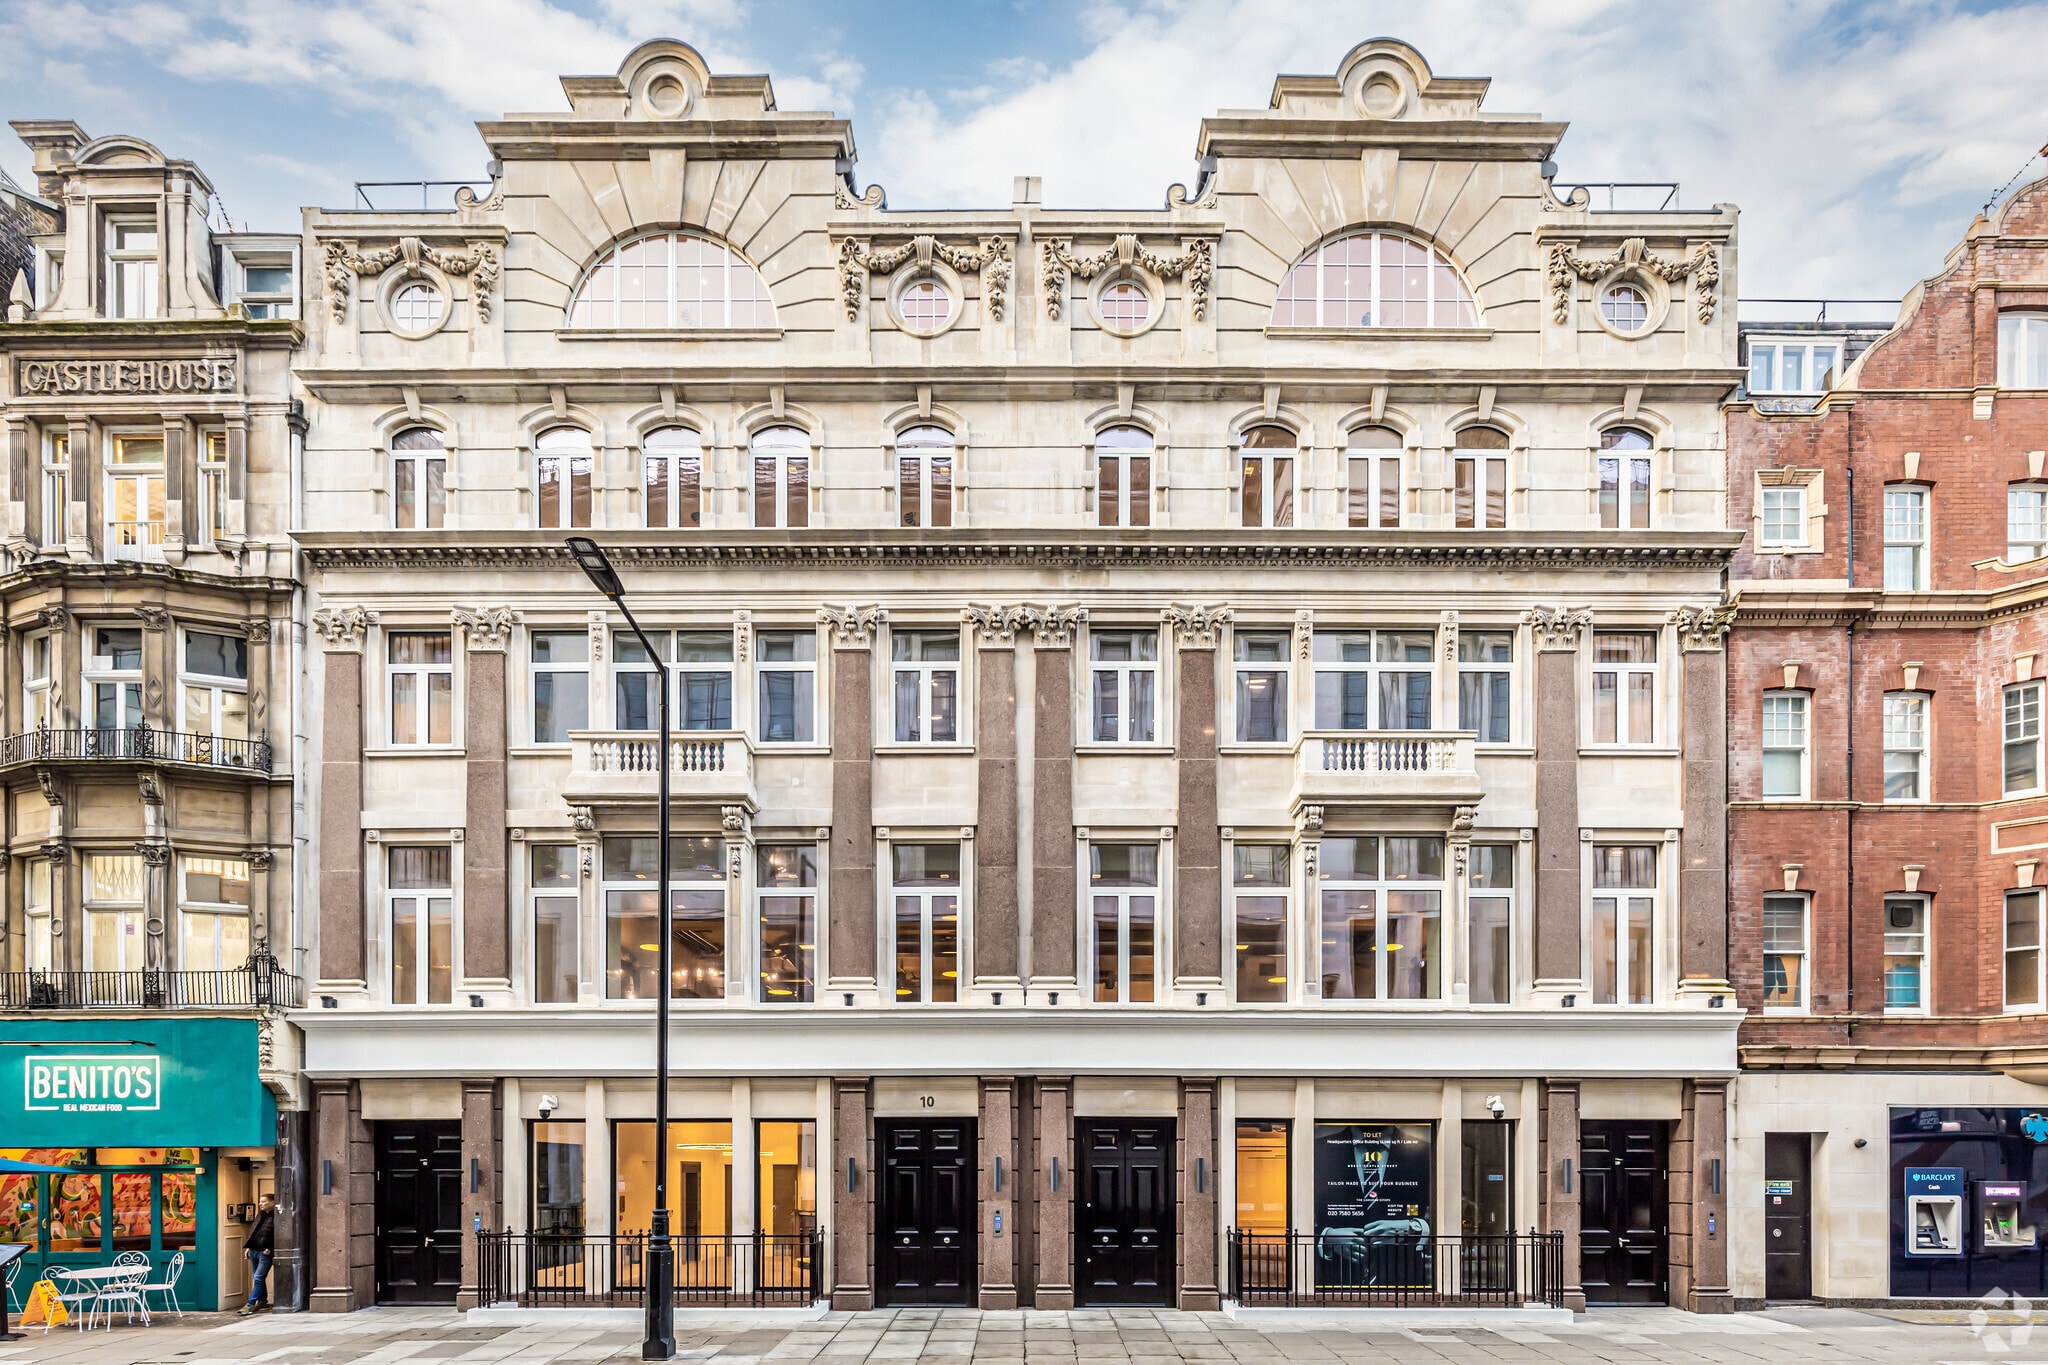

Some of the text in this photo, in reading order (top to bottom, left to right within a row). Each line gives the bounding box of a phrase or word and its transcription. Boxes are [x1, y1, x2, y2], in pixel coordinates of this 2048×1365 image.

[24, 360, 232, 392] CASTLE HOUSE
[33, 1065, 152, 1099] BENITO'S
[919, 1096, 935, 1108] 10
[63, 1104, 123, 1112] REAL MEXICAN FOOD
[169, 1150, 181, 1158] WE
[1364, 1151, 1382, 1162] 10
